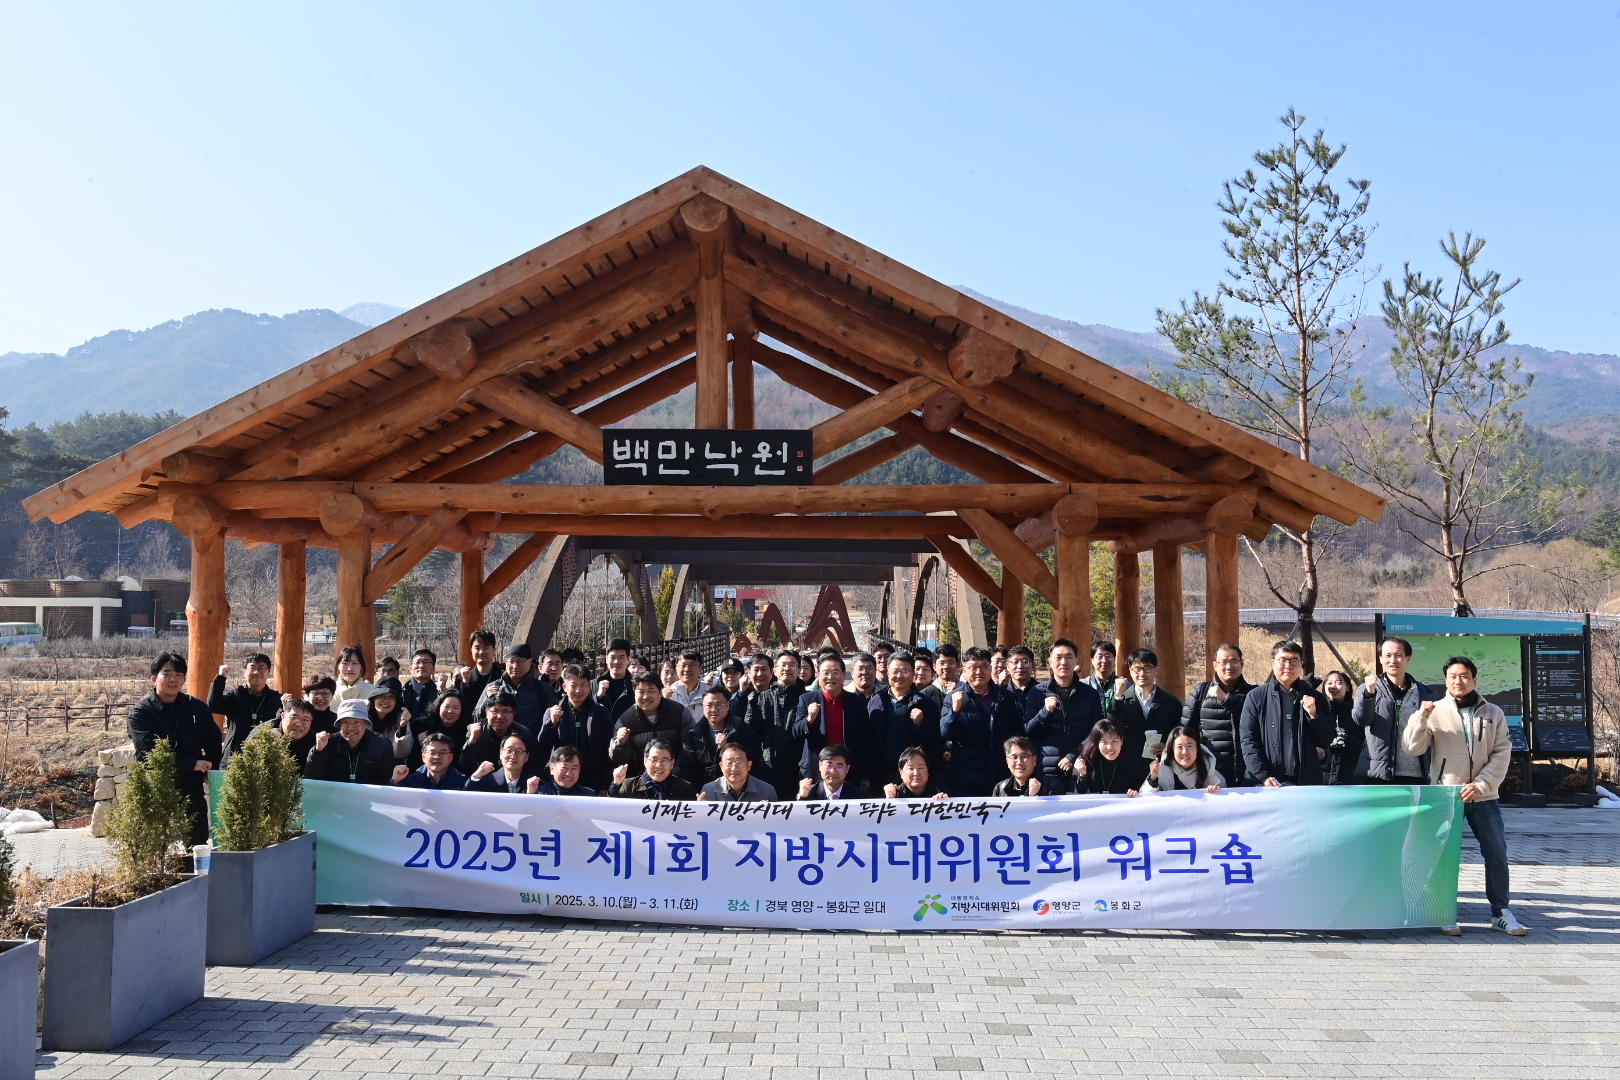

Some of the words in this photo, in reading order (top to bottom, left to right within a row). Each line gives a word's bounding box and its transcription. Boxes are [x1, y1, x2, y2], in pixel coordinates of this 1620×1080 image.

[612, 439, 788, 477] 백만낙원
[641, 801, 697, 822] 이제는
[707, 801, 794, 822] 지방시대
[806, 803, 849, 821] 다시
[859, 802, 897, 824] 뛰는
[907, 801, 1011, 825] 대한민국!
[403, 827, 562, 881] 2025년
[586, 830, 710, 882] 제1회
[735, 831, 1081, 887] 지방시대위원회
[1106, 832, 1264, 886] 워크숍
[519, 892, 541, 905] 일시
[554, 894, 586, 907] 2025.
[588, 896, 599, 907] 3.
[602, 896, 637, 910] 10.(월)
[649, 898, 659, 909] 3.
[663, 898, 699, 911] 11.(화)
[727, 899, 750, 912] 장소
[765, 899, 788, 913] 경북
[791, 900, 815, 914] 영양
[826, 900, 860, 914] 봉화군
[863, 900, 886, 914] 일대
[950, 901, 1020, 913] 지방시대위원회
[1051, 901, 1081, 911] 영양군
[1110, 901, 1141, 911] 봉화군
